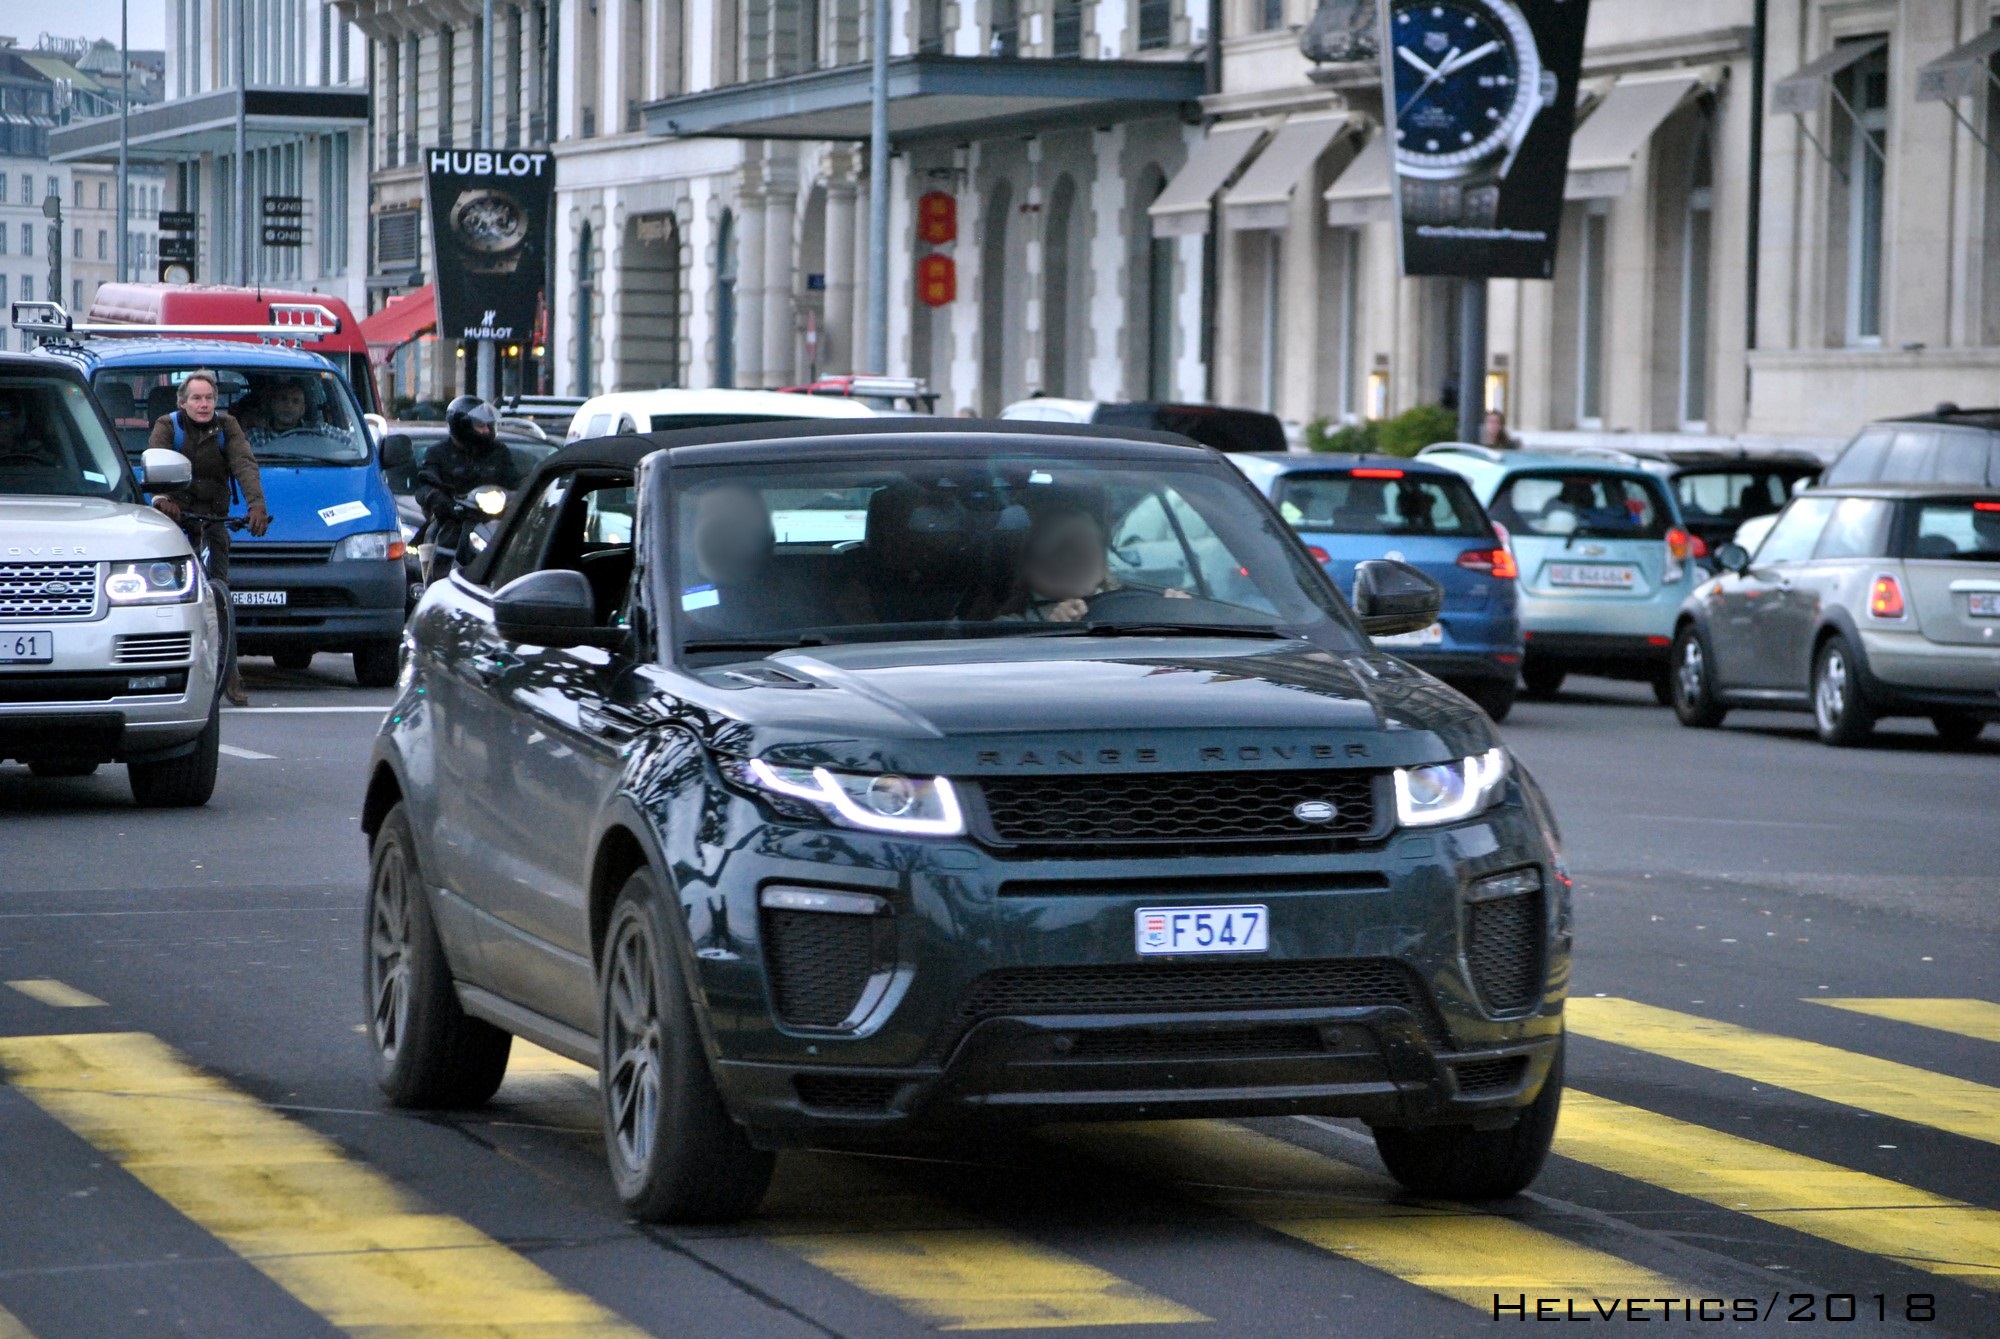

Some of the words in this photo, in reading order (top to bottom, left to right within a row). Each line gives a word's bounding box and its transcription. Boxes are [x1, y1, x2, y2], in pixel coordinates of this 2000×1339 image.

[431, 151, 547, 176] HUBLOT
[277, 201, 300, 211] QNB
[277, 230, 300, 240] QNB
[464, 327, 512, 339] HUBLOT
[8, 547, 87, 556] OVER
[232, 593, 244, 604] GE
[247, 593, 284, 604] 815441
[15, 636, 37, 656] 61
[976, 749, 1160, 766] RANGE
[1200, 744, 1371, 761] ROVER
[1172, 913, 1259, 947] F547
